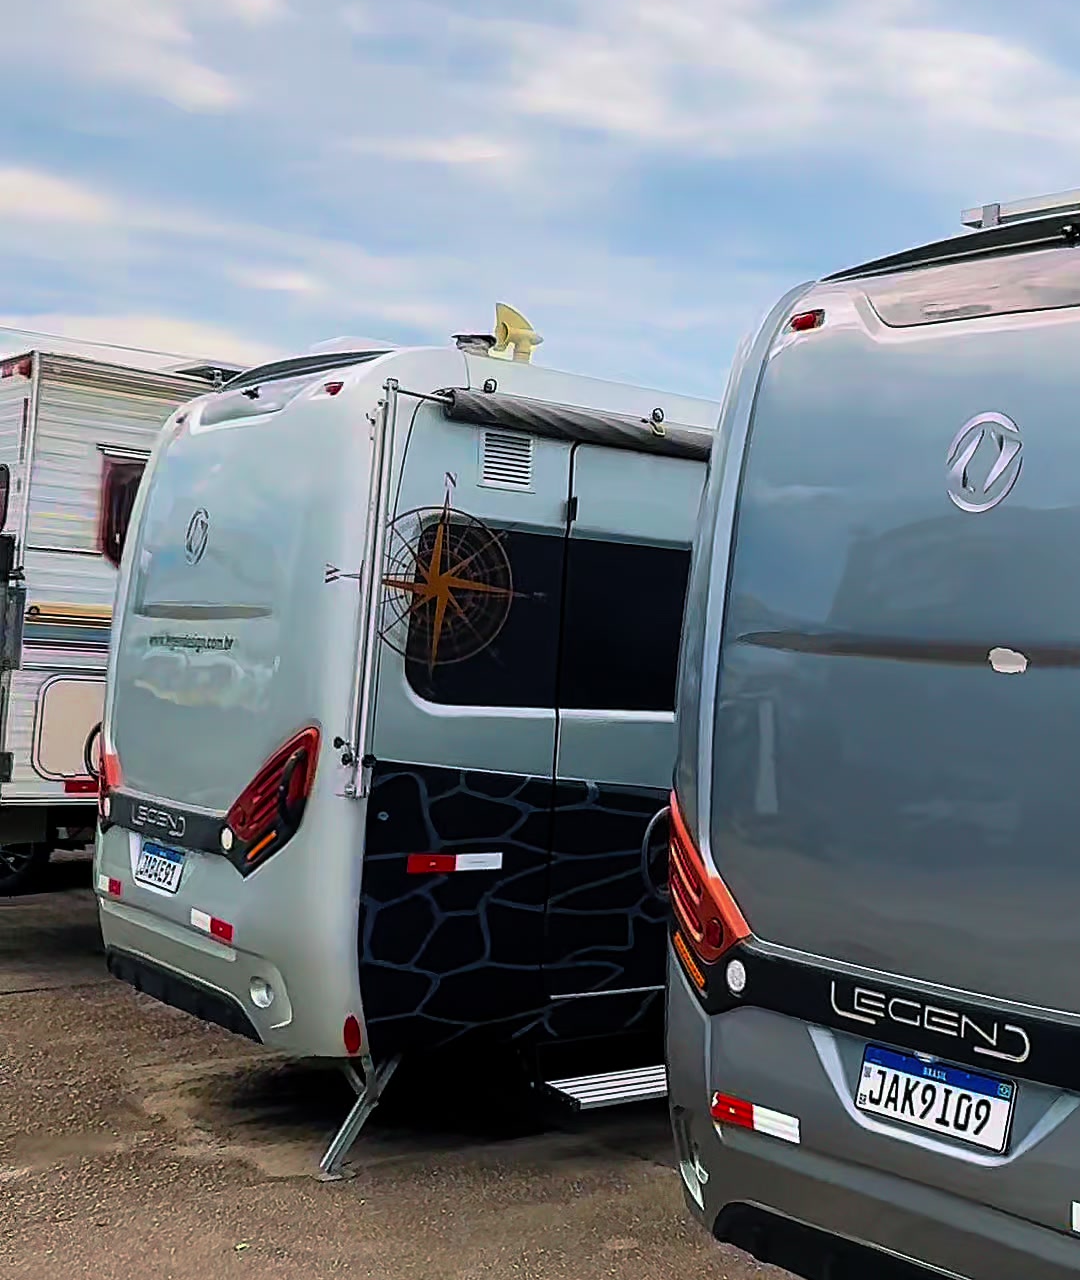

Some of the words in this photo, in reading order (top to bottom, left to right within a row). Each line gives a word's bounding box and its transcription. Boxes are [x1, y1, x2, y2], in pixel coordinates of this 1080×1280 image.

[444, 472, 457, 488] N
[131, 803, 186, 837] LEGEND
[831, 980, 1030, 1063] LEGEND
[922, 1066, 947, 1082] BRASIL
